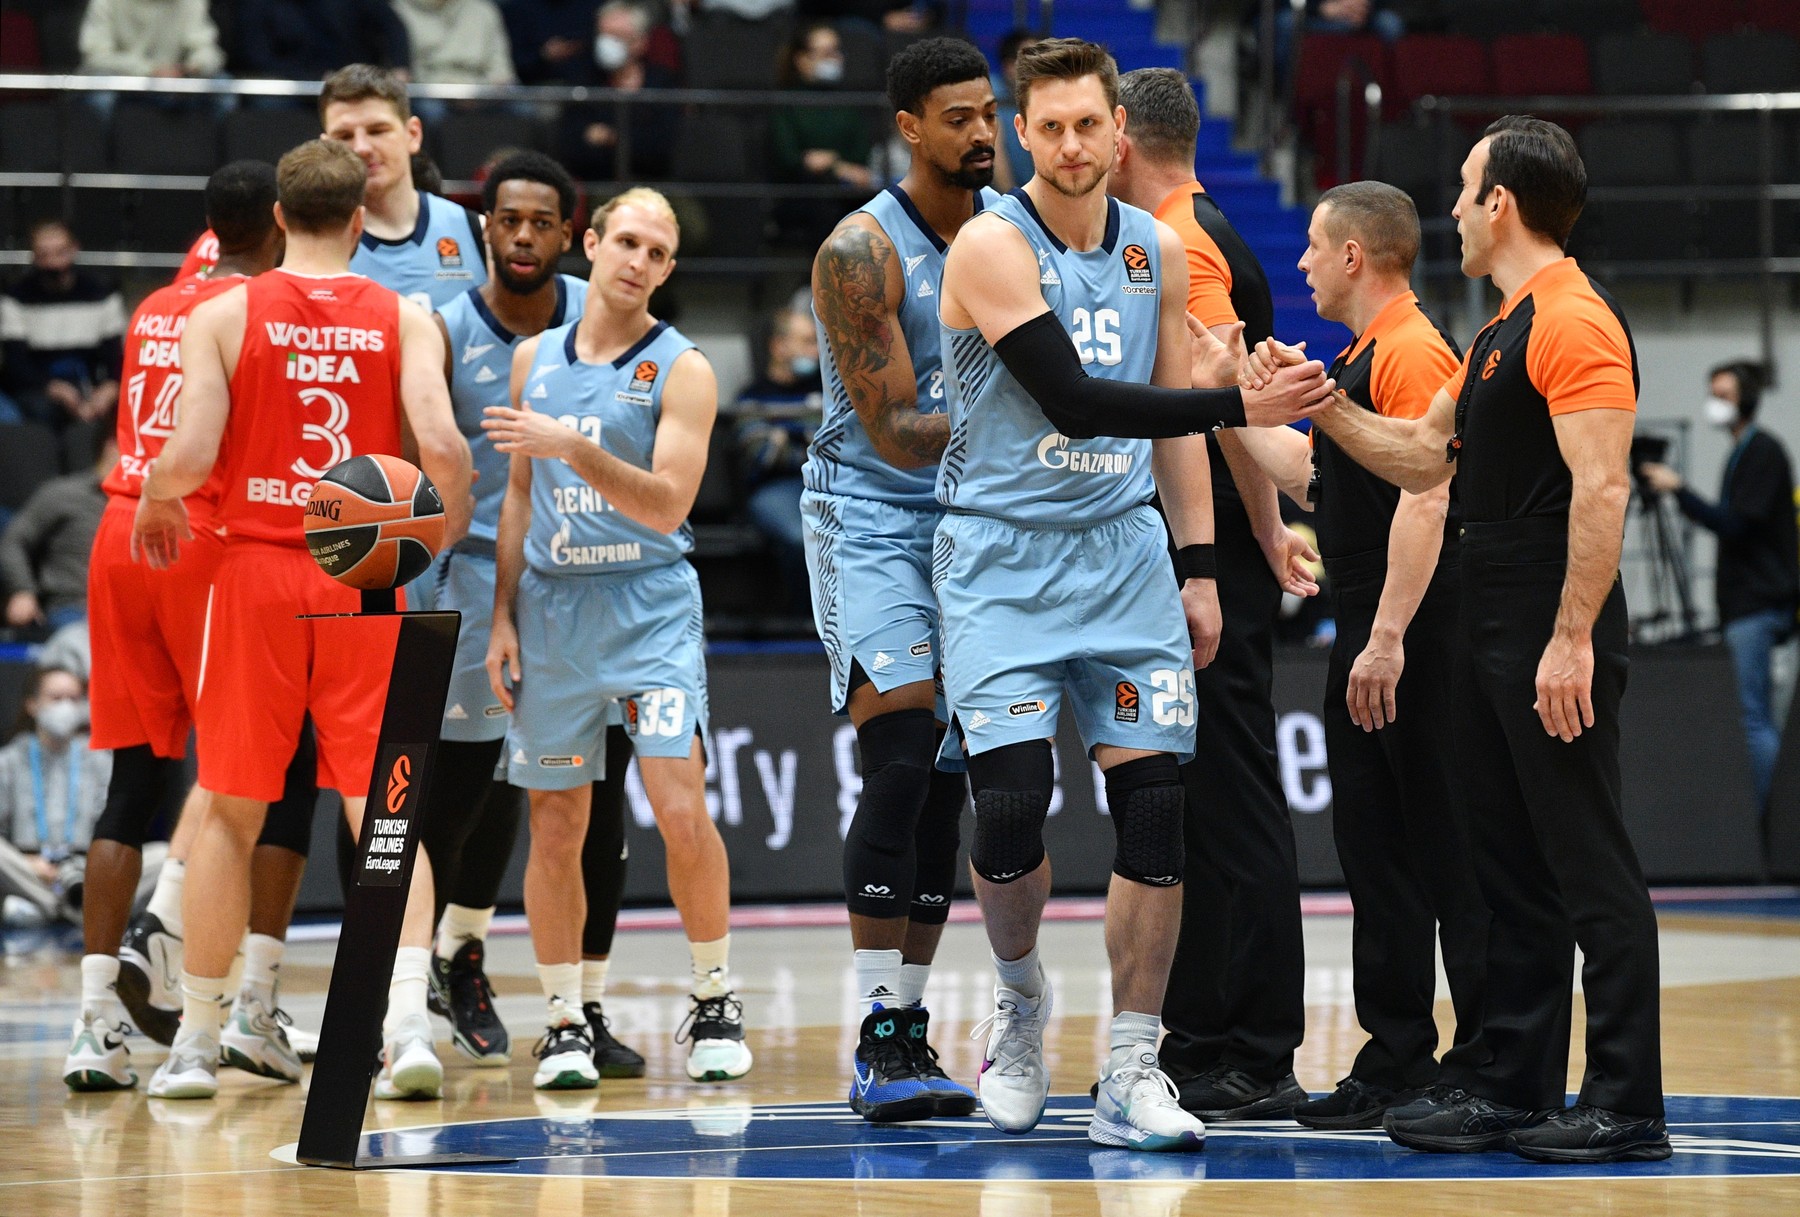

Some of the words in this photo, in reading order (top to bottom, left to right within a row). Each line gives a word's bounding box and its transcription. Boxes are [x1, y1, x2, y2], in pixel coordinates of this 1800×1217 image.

[264, 321, 385, 353] WOLTERS
[1072, 307, 1122, 366] 25
[290, 386, 353, 479] 3
[1069, 451, 1133, 474] GAZPROM
[571, 542, 642, 566] GAZPROM
[639, 687, 686, 737] 33
[1151, 669, 1195, 727] 25
[373, 819, 409, 835] TURKISH
[368, 837, 405, 853] AIRLINES
[365, 855, 401, 874] EuroLeague
